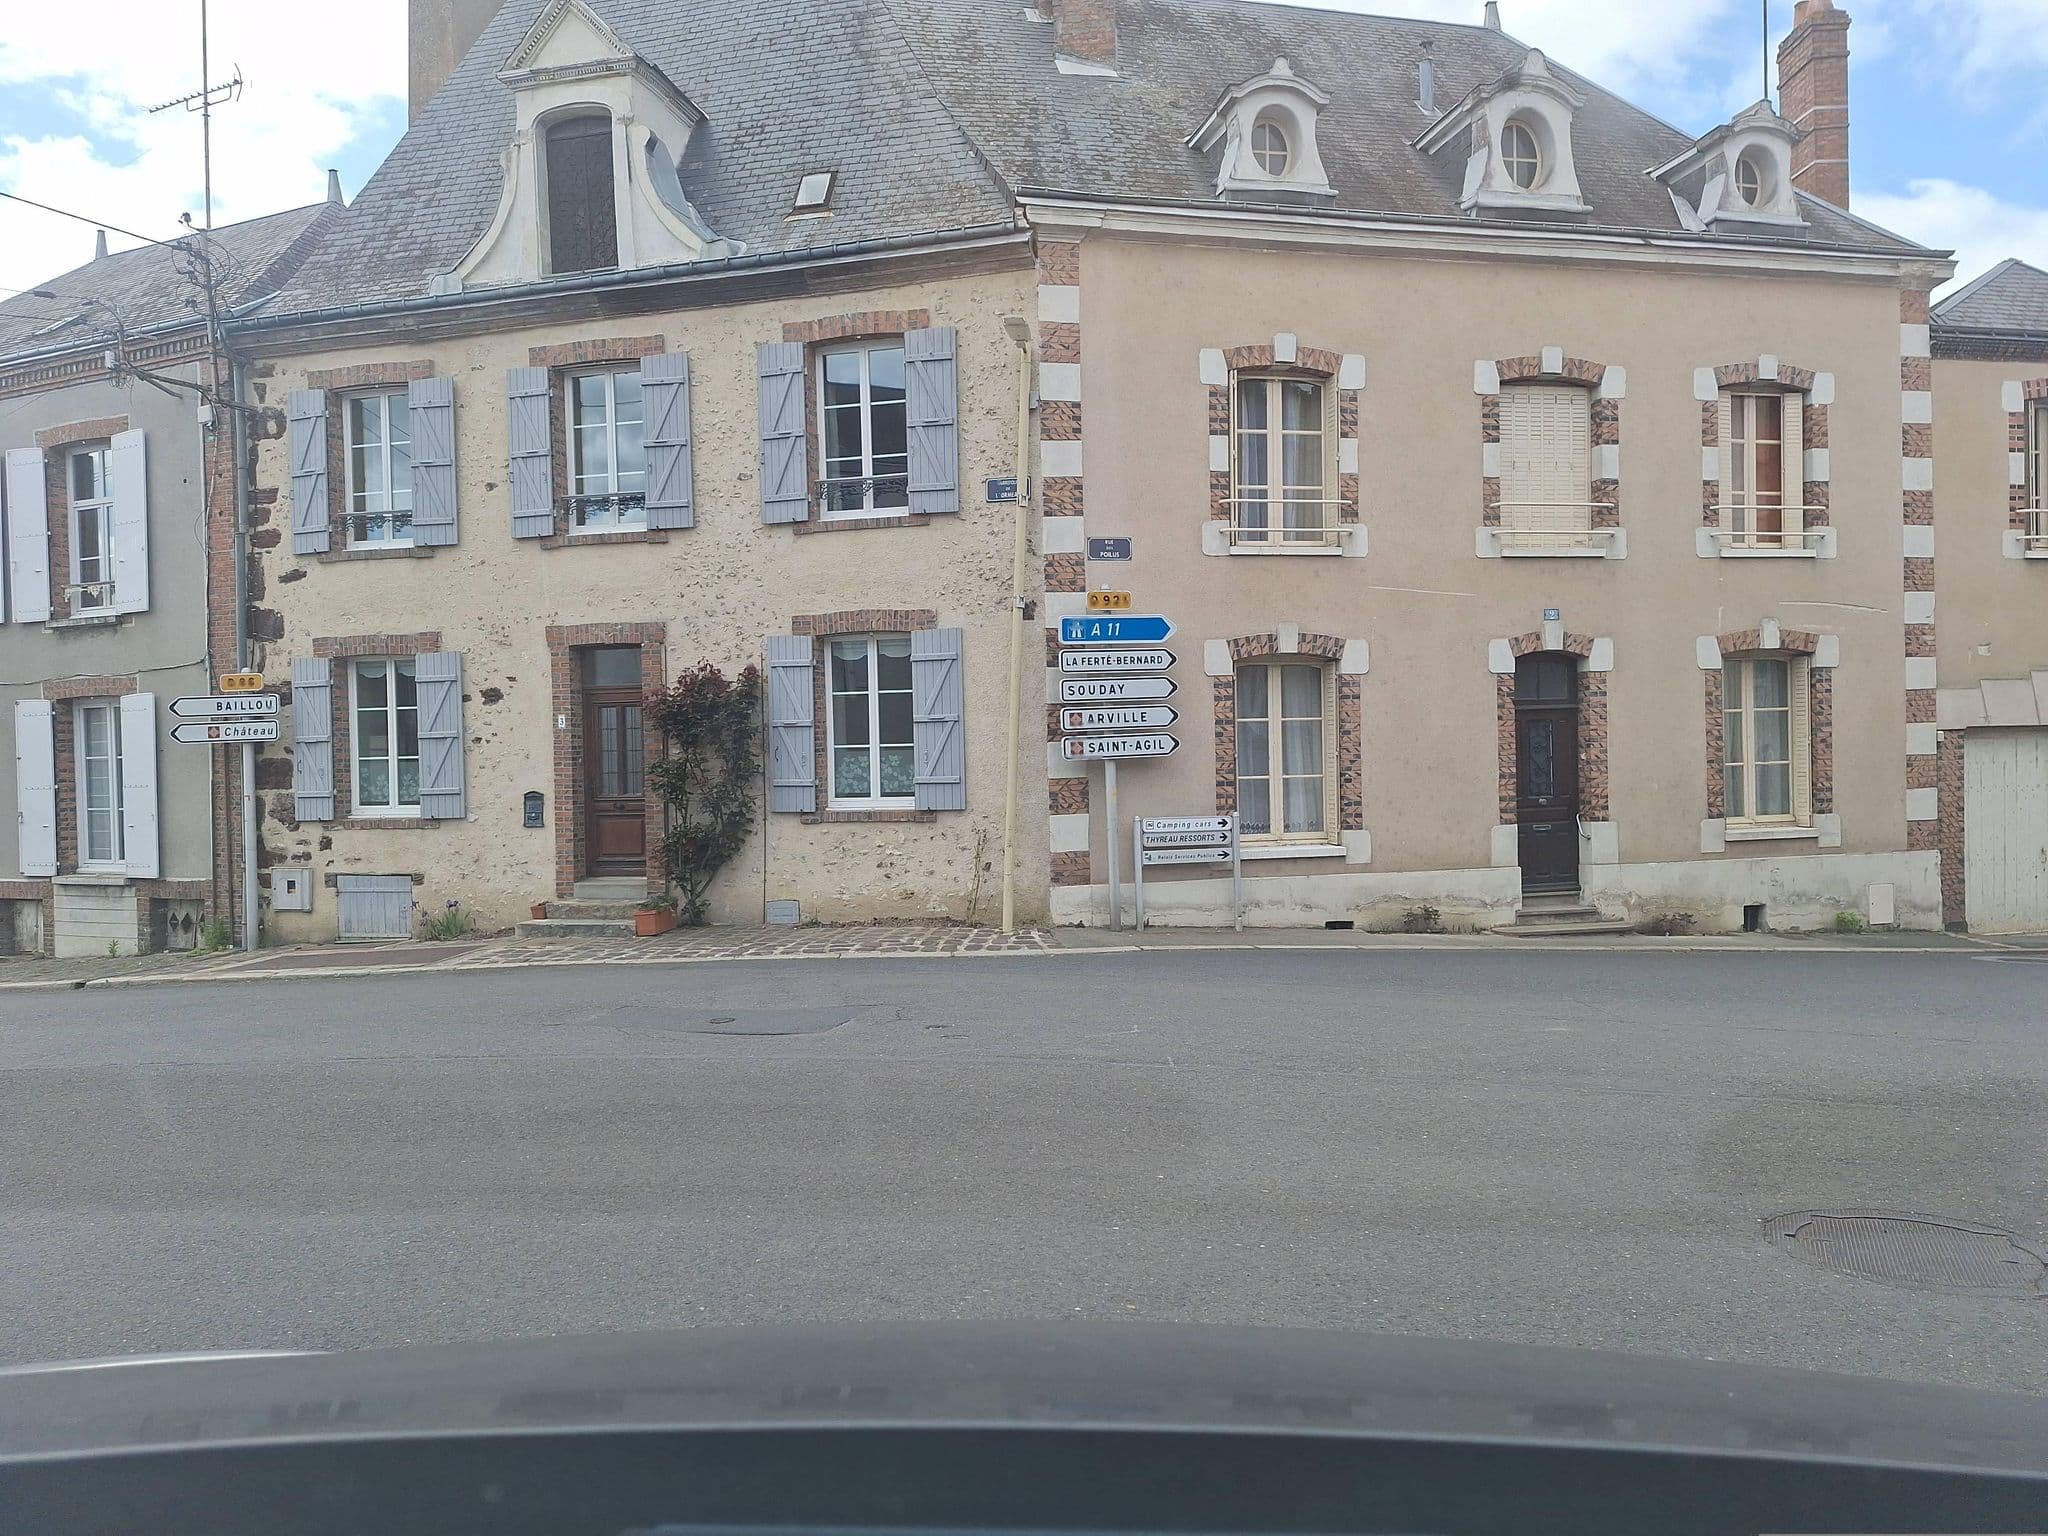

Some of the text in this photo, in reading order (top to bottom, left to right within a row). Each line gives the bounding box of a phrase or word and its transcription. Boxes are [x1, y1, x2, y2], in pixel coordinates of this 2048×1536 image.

[1091, 622, 1121, 636] A 11
[1066, 654, 1163, 667] LA FERTÉ-BERNARD
[1067, 683, 1125, 696] SOUDAY
[216, 700, 273, 711] BAILLOU
[1087, 711, 1148, 724] ARVILLE
[224, 726, 274, 737] Château
[1088, 739, 1165, 753] SAINT-AGIL
[1156, 821, 1191, 829] Camping
[1179, 833, 1215, 842] RESSORTS
